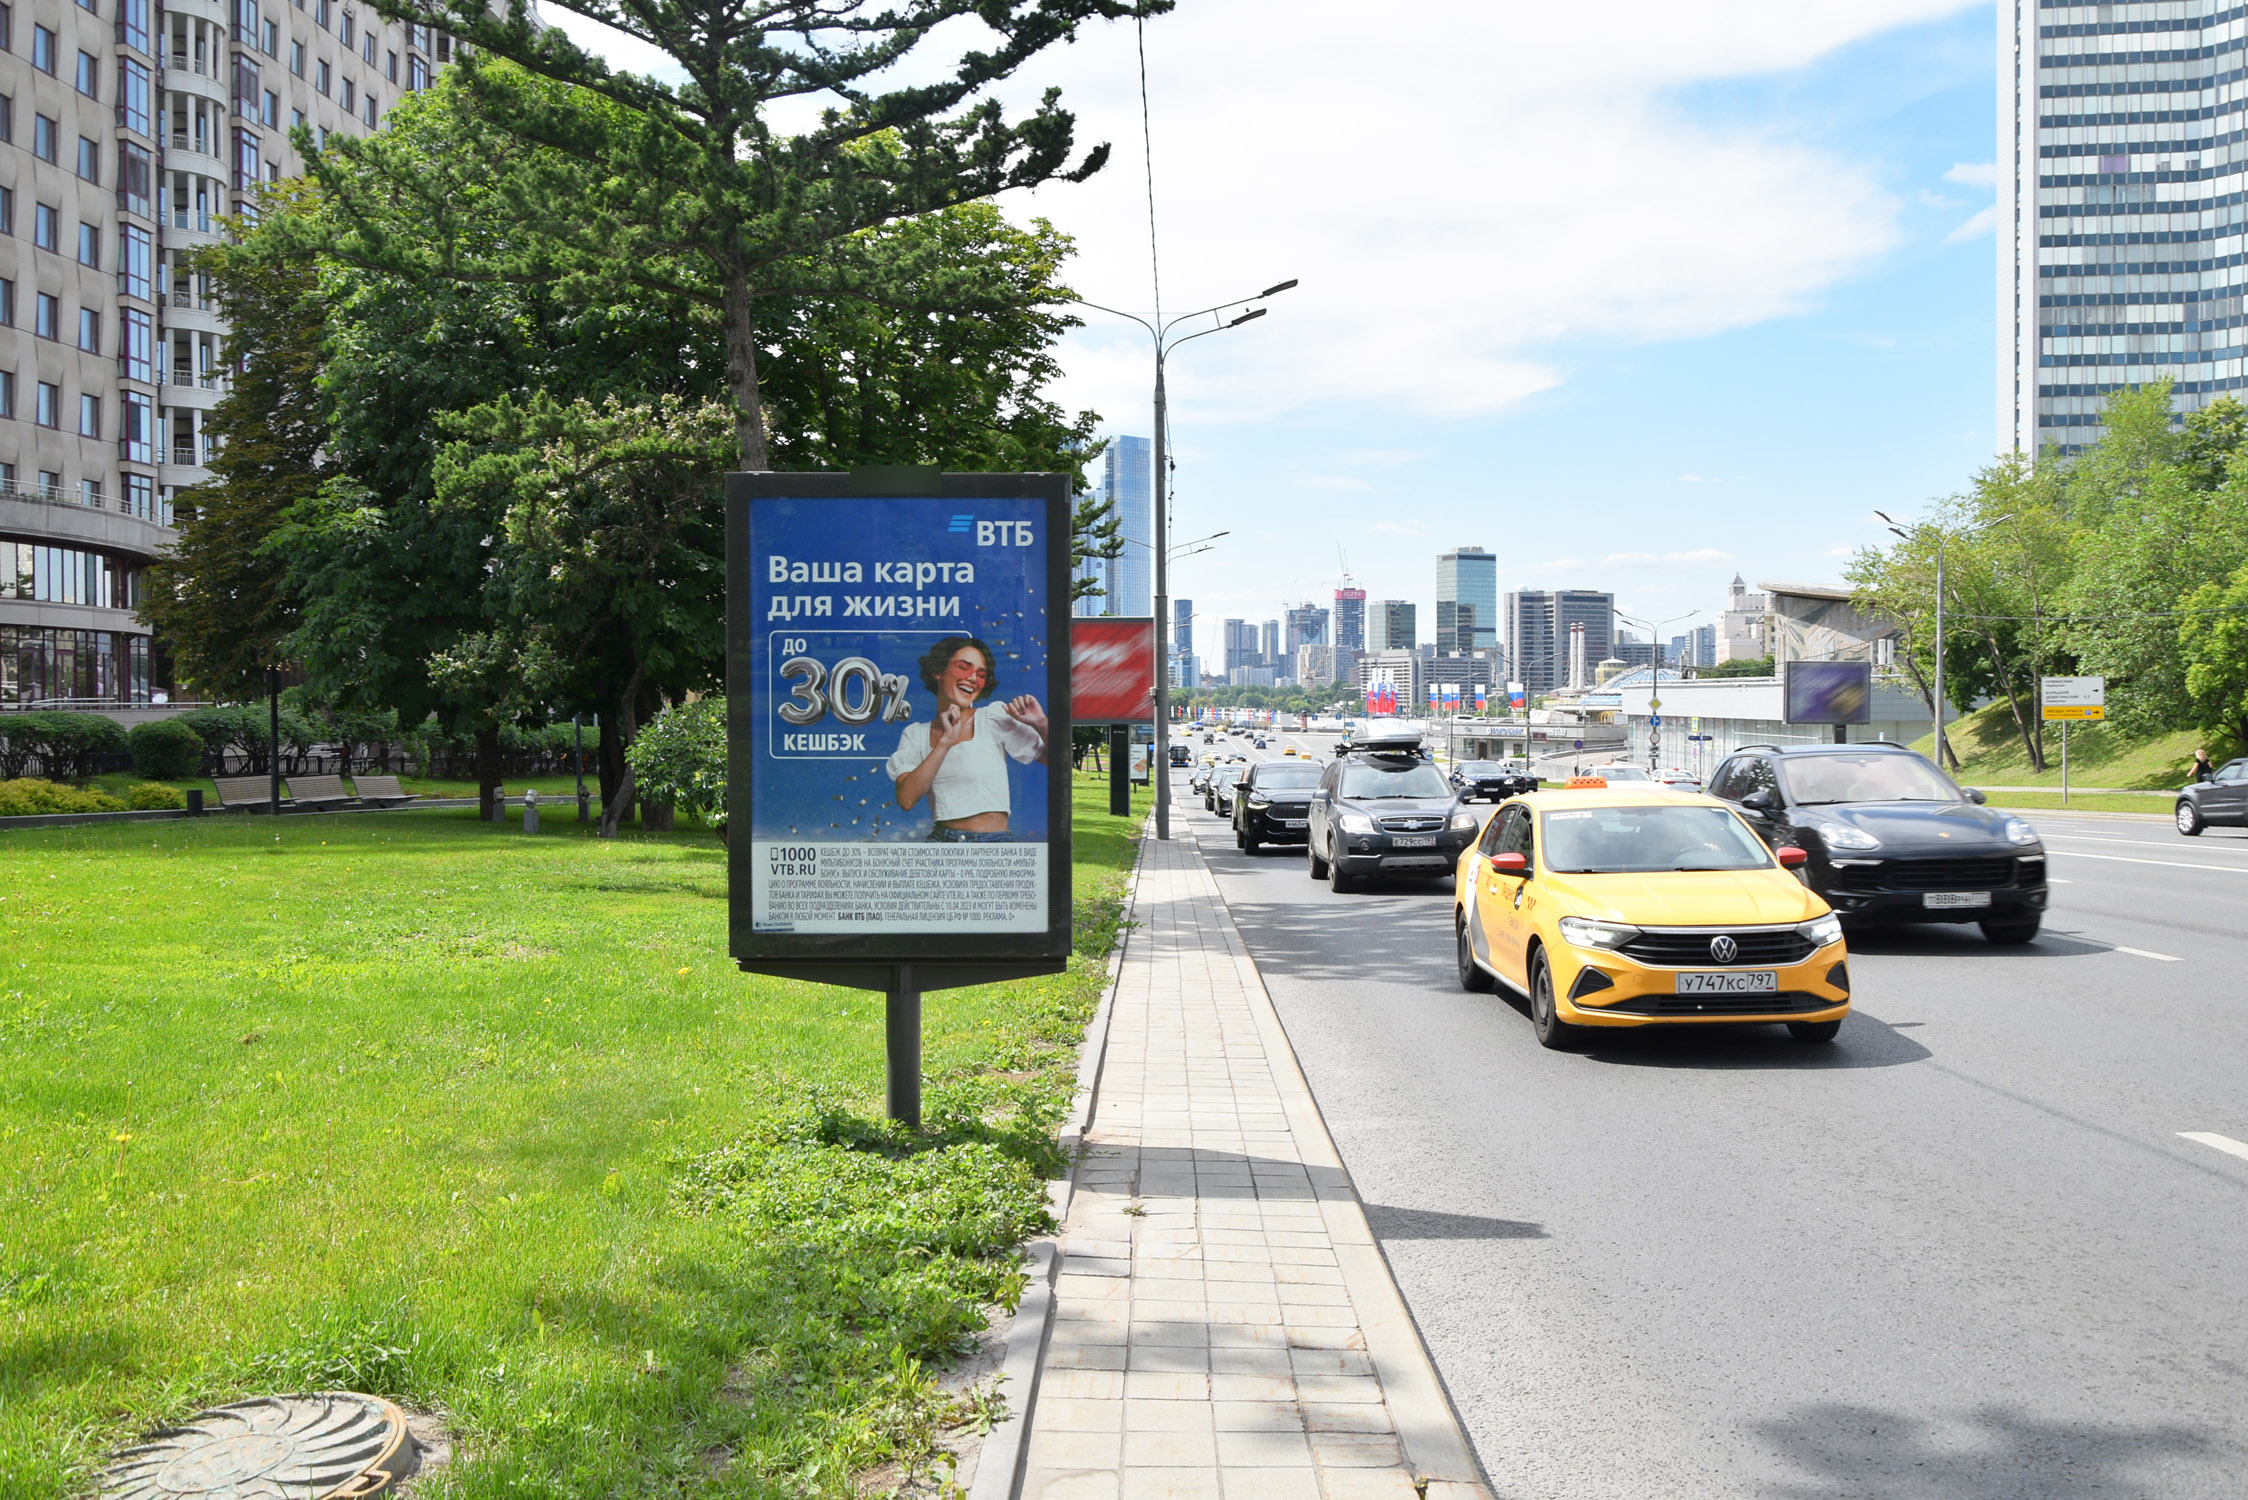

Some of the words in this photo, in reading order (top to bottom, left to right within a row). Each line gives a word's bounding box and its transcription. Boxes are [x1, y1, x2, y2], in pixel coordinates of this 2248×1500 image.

[976, 520, 1034, 546] ВТБ
[769, 555, 863, 583] Ваша
[874, 561, 975, 591] карта
[767, 595, 833, 622] для
[843, 595, 960, 617] жизни
[778, 656, 912, 727] 30%
[784, 733, 866, 751] КЕШБЭК
[780, 848, 816, 862] 1000
[770, 864, 816, 876] VTB.RU
[838, 912, 853, 920] БАНК
[855, 912, 864, 920] ВТБ
[1684, 976, 1746, 990] У747КС
[1748, 974, 1772, 986] 797
